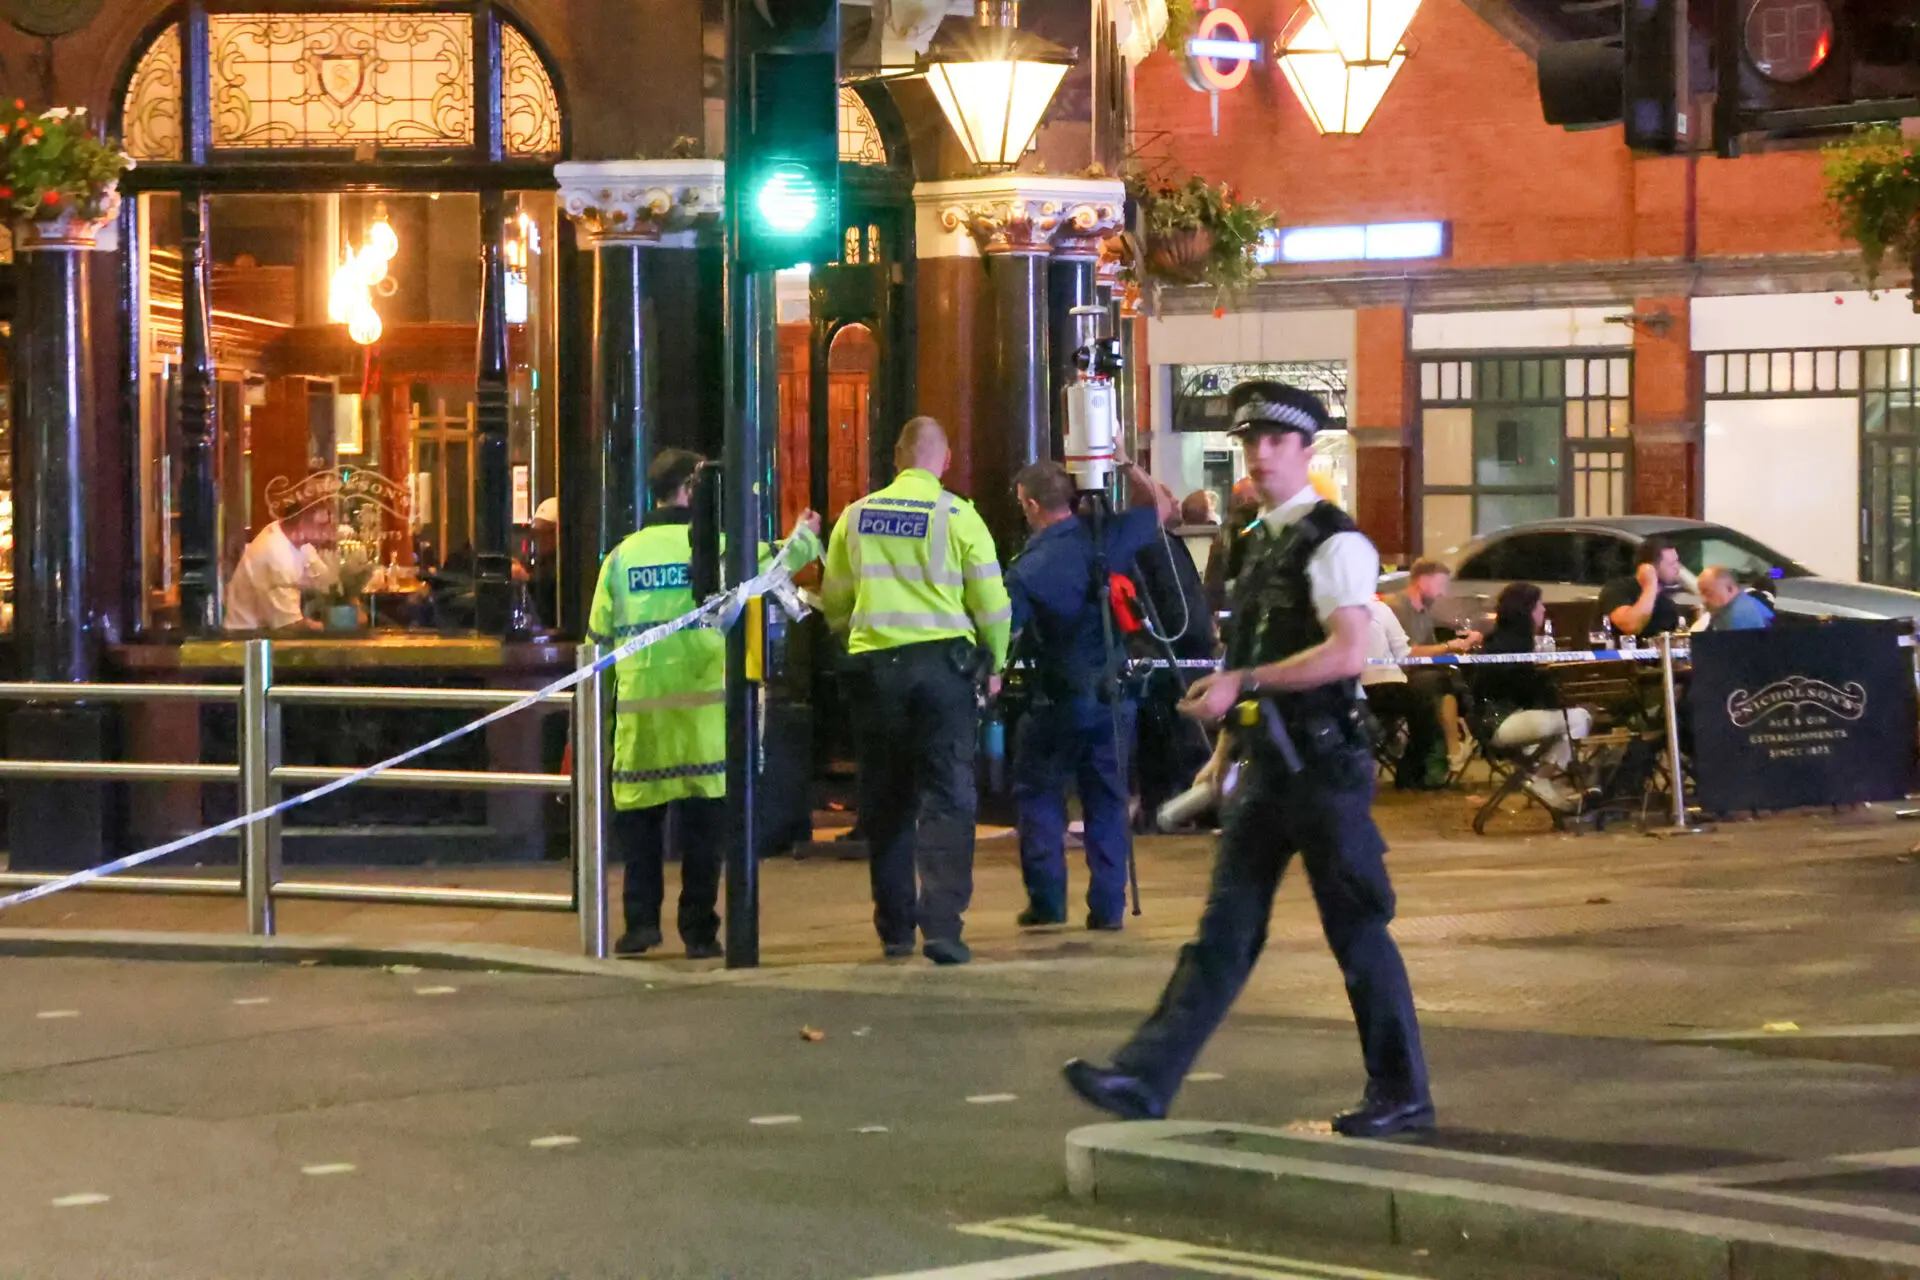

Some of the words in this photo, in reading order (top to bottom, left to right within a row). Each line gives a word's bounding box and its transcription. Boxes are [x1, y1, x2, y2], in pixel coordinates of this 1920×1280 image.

[861, 518, 925, 536] POLICE
[630, 566, 689, 589] POLICE
[1741, 688, 1852, 715] NICHOLSON'S
[1769, 718, 1789, 726] ALE
[1794, 718, 1801, 726] &
[1806, 716, 1827, 725] GIN
[1749, 730, 1848, 744] ESTABLISHMENTS
[1769, 747, 1802, 759] SINCE
